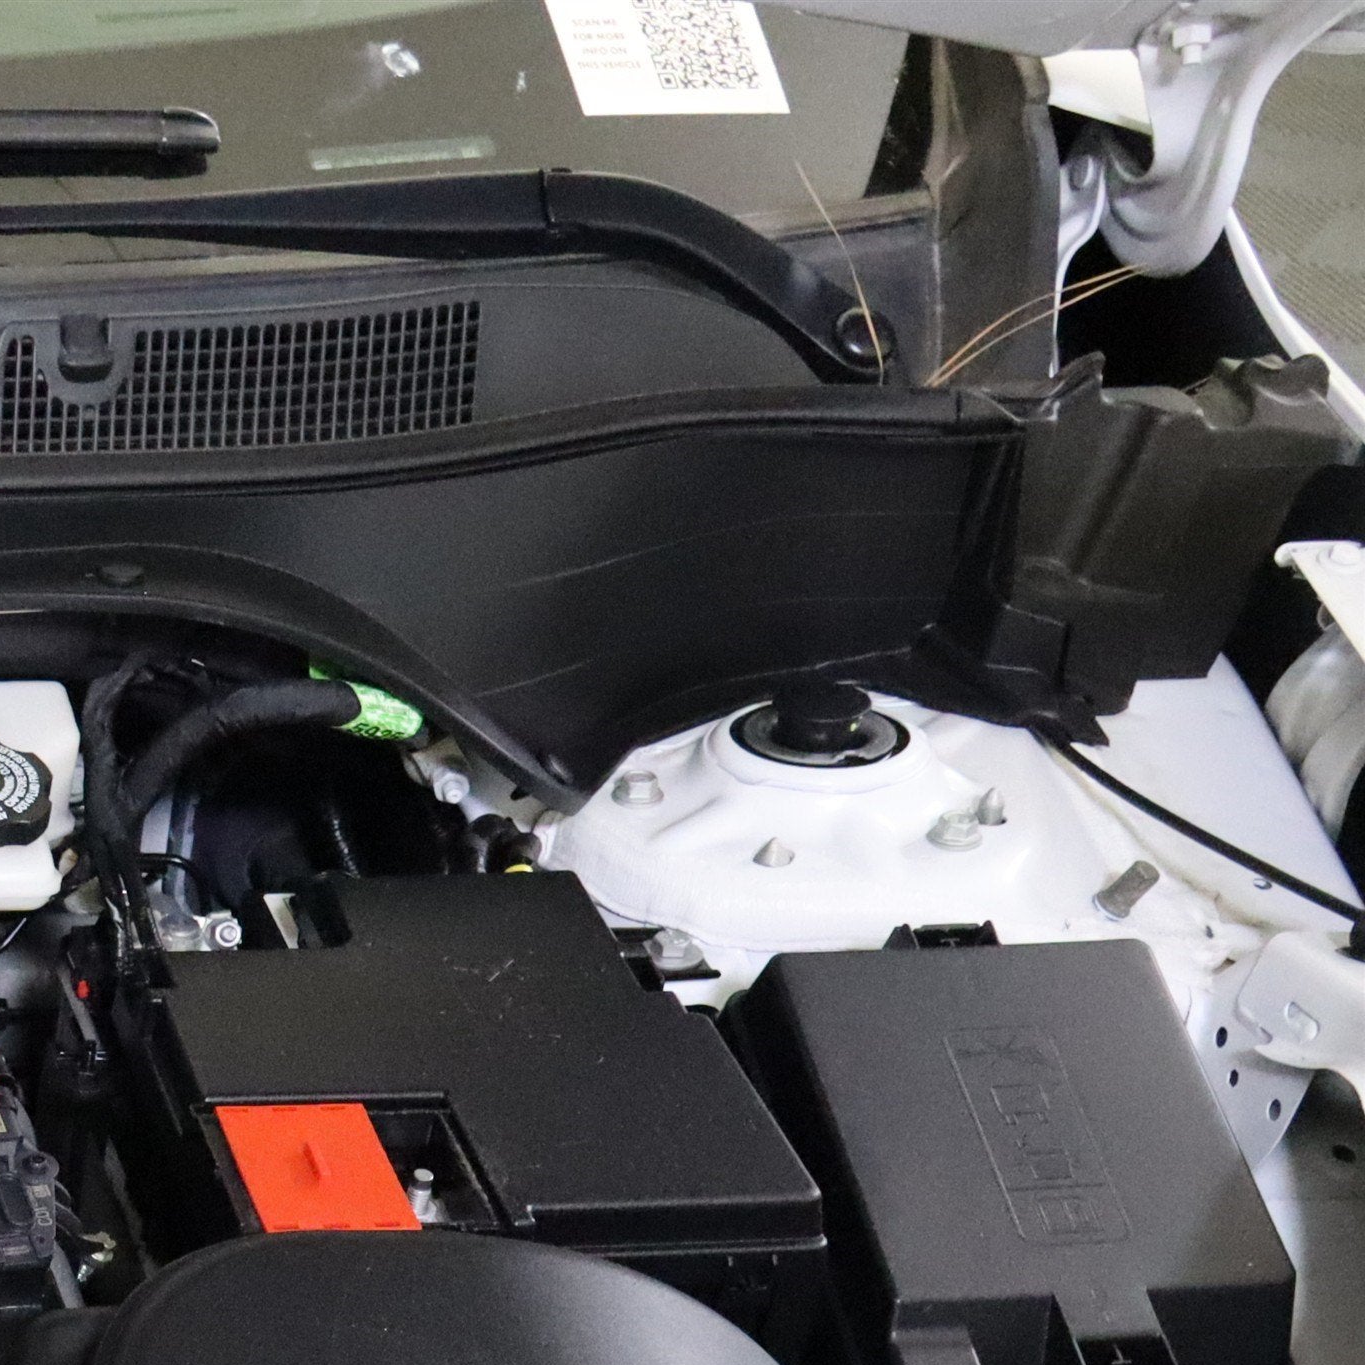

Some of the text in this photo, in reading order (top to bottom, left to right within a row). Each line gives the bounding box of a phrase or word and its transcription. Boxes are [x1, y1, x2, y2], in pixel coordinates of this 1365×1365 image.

[572, 18, 617, 27] SCAN ME
[596, 32, 625, 40] MORE
[582, 47, 627, 55] INFO ON
[577, 61, 642, 69] THIS VEHICLE
